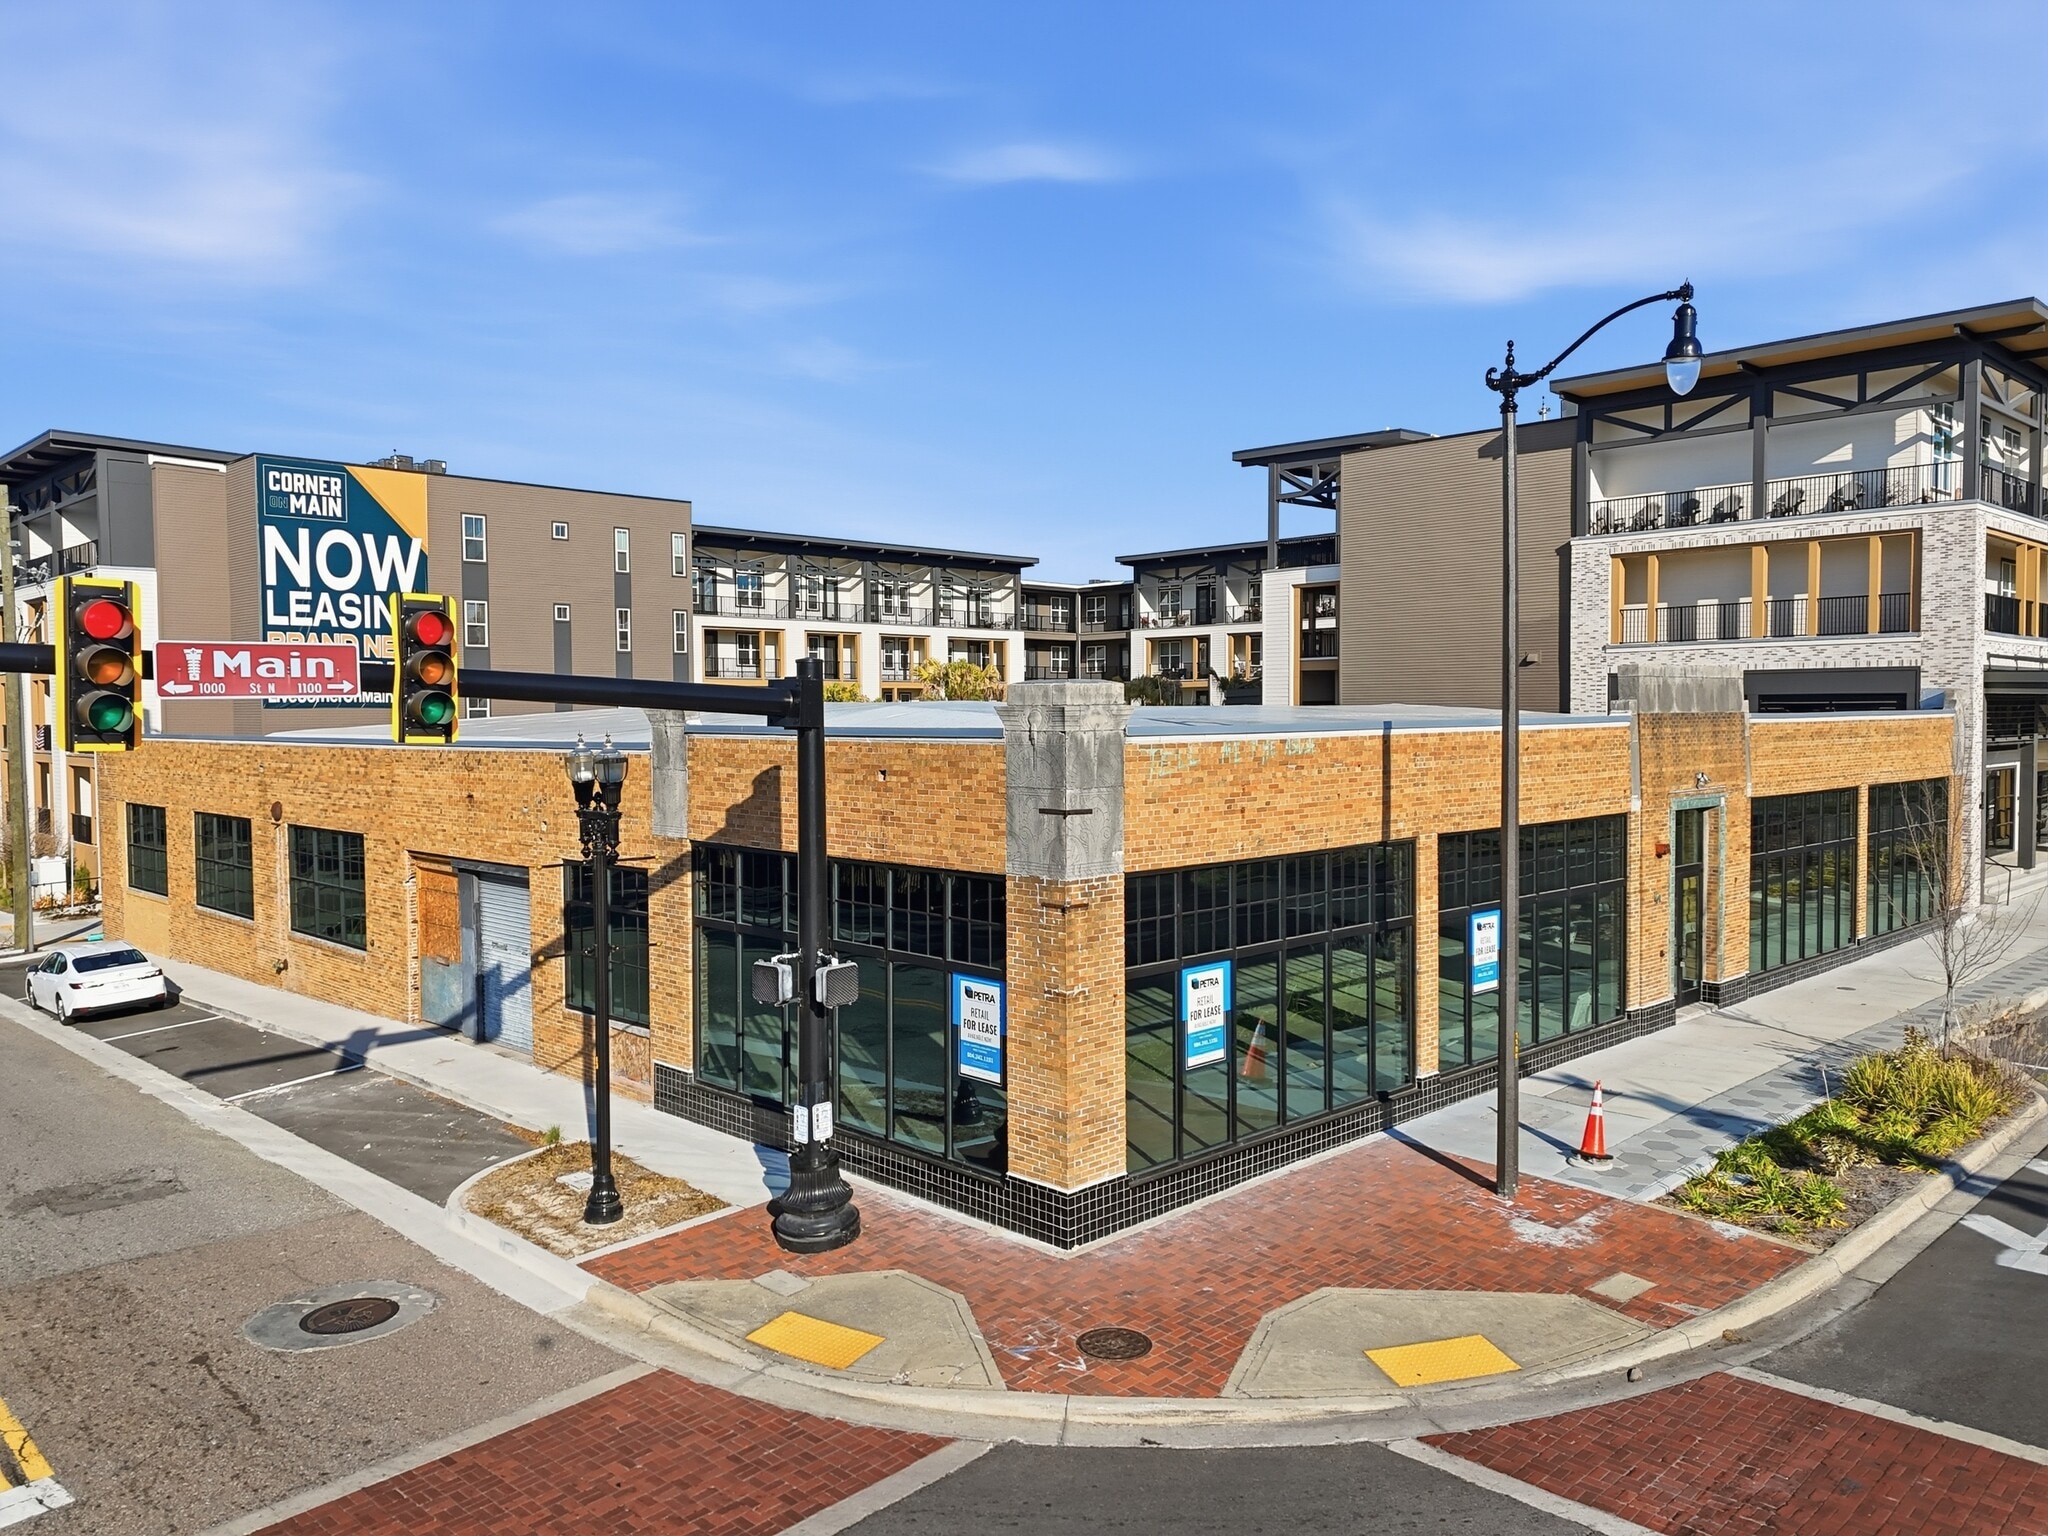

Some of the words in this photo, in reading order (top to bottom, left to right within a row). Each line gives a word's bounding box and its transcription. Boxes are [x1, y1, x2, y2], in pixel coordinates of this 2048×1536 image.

[268, 470, 342, 498] CORNER
[269, 495, 289, 509] ON
[290, 493, 343, 518] MAIN
[263, 525, 423, 593] NOW
[266, 589, 394, 629] LEASIN
[363, 634, 395, 659] NE
[213, 650, 335, 678] Main
[199, 682, 226, 694] 1000
[250, 682, 262, 694] St
[268, 683, 276, 694] N
[297, 682, 322, 694] 1100
[1200, 977, 1220, 989] PETRA
[973, 991, 996, 1004] PETRA
[970, 1007, 990, 1021] RETAIL
[1190, 1010, 1203, 1021] FOR
[1203, 1005, 1221, 1018] LEASE
[963, 1018, 977, 1031] FOR
[977, 1021, 998, 1036] LEASE
